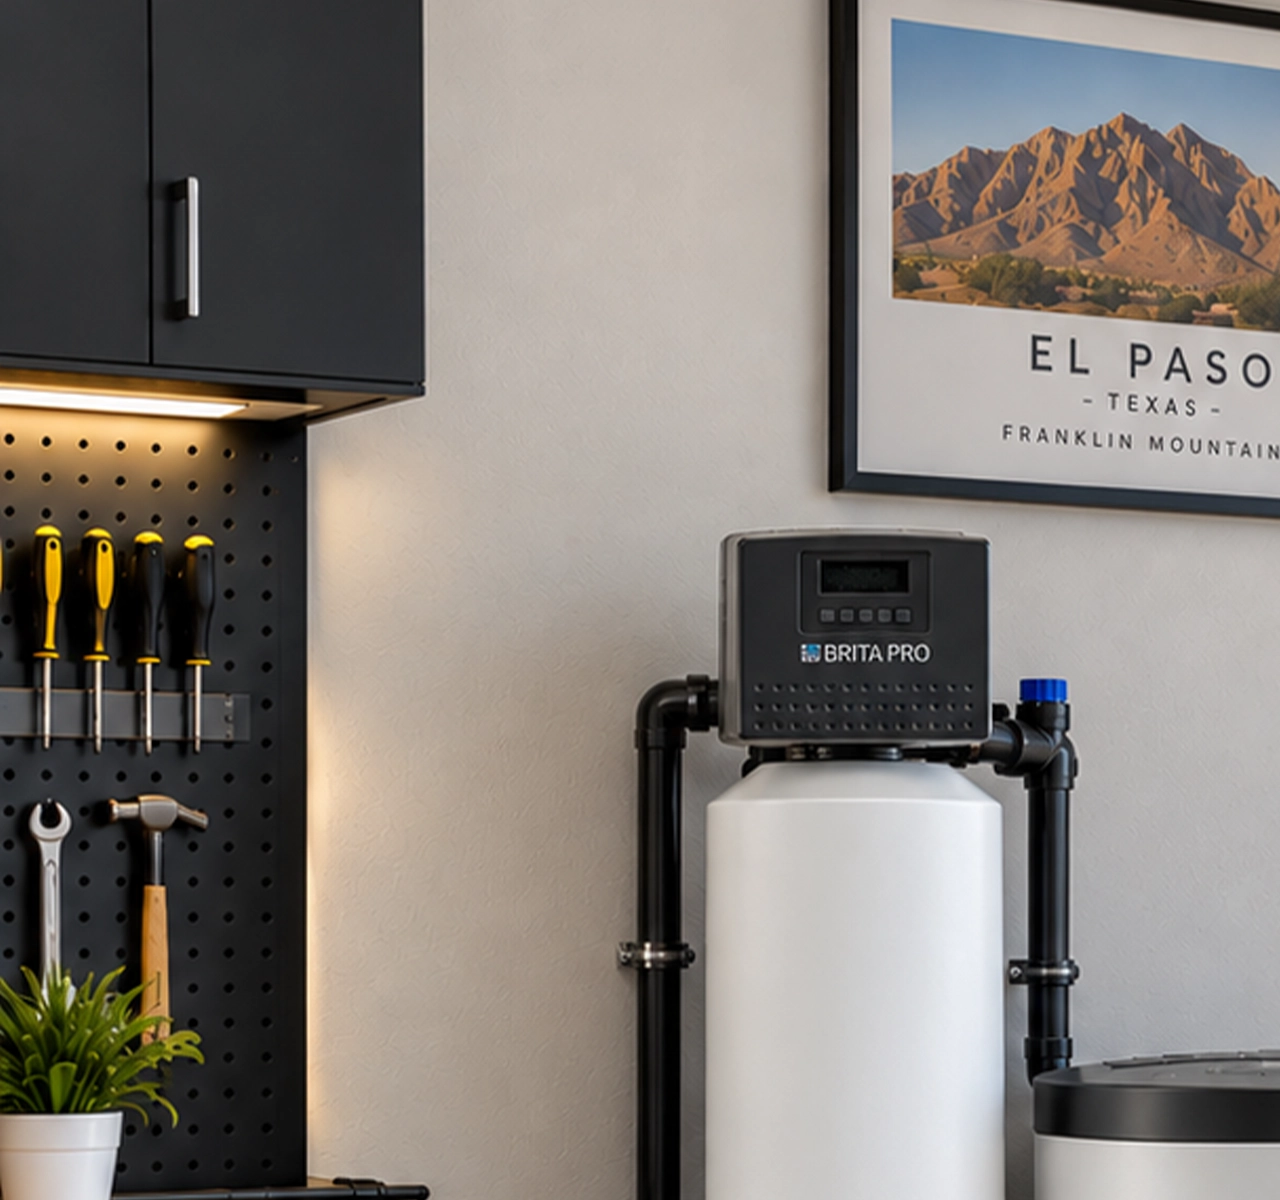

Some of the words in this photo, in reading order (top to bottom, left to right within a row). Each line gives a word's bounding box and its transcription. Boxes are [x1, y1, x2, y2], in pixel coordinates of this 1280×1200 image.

[1030, 334, 1090, 375] EL
[1129, 342, 1272, 388] PASO
[1107, 392, 1196, 417] TEXAS
[1002, 424, 1132, 450] FRANKLIN
[824, 643, 884, 662] BRITA
[887, 643, 931, 663] PRO
